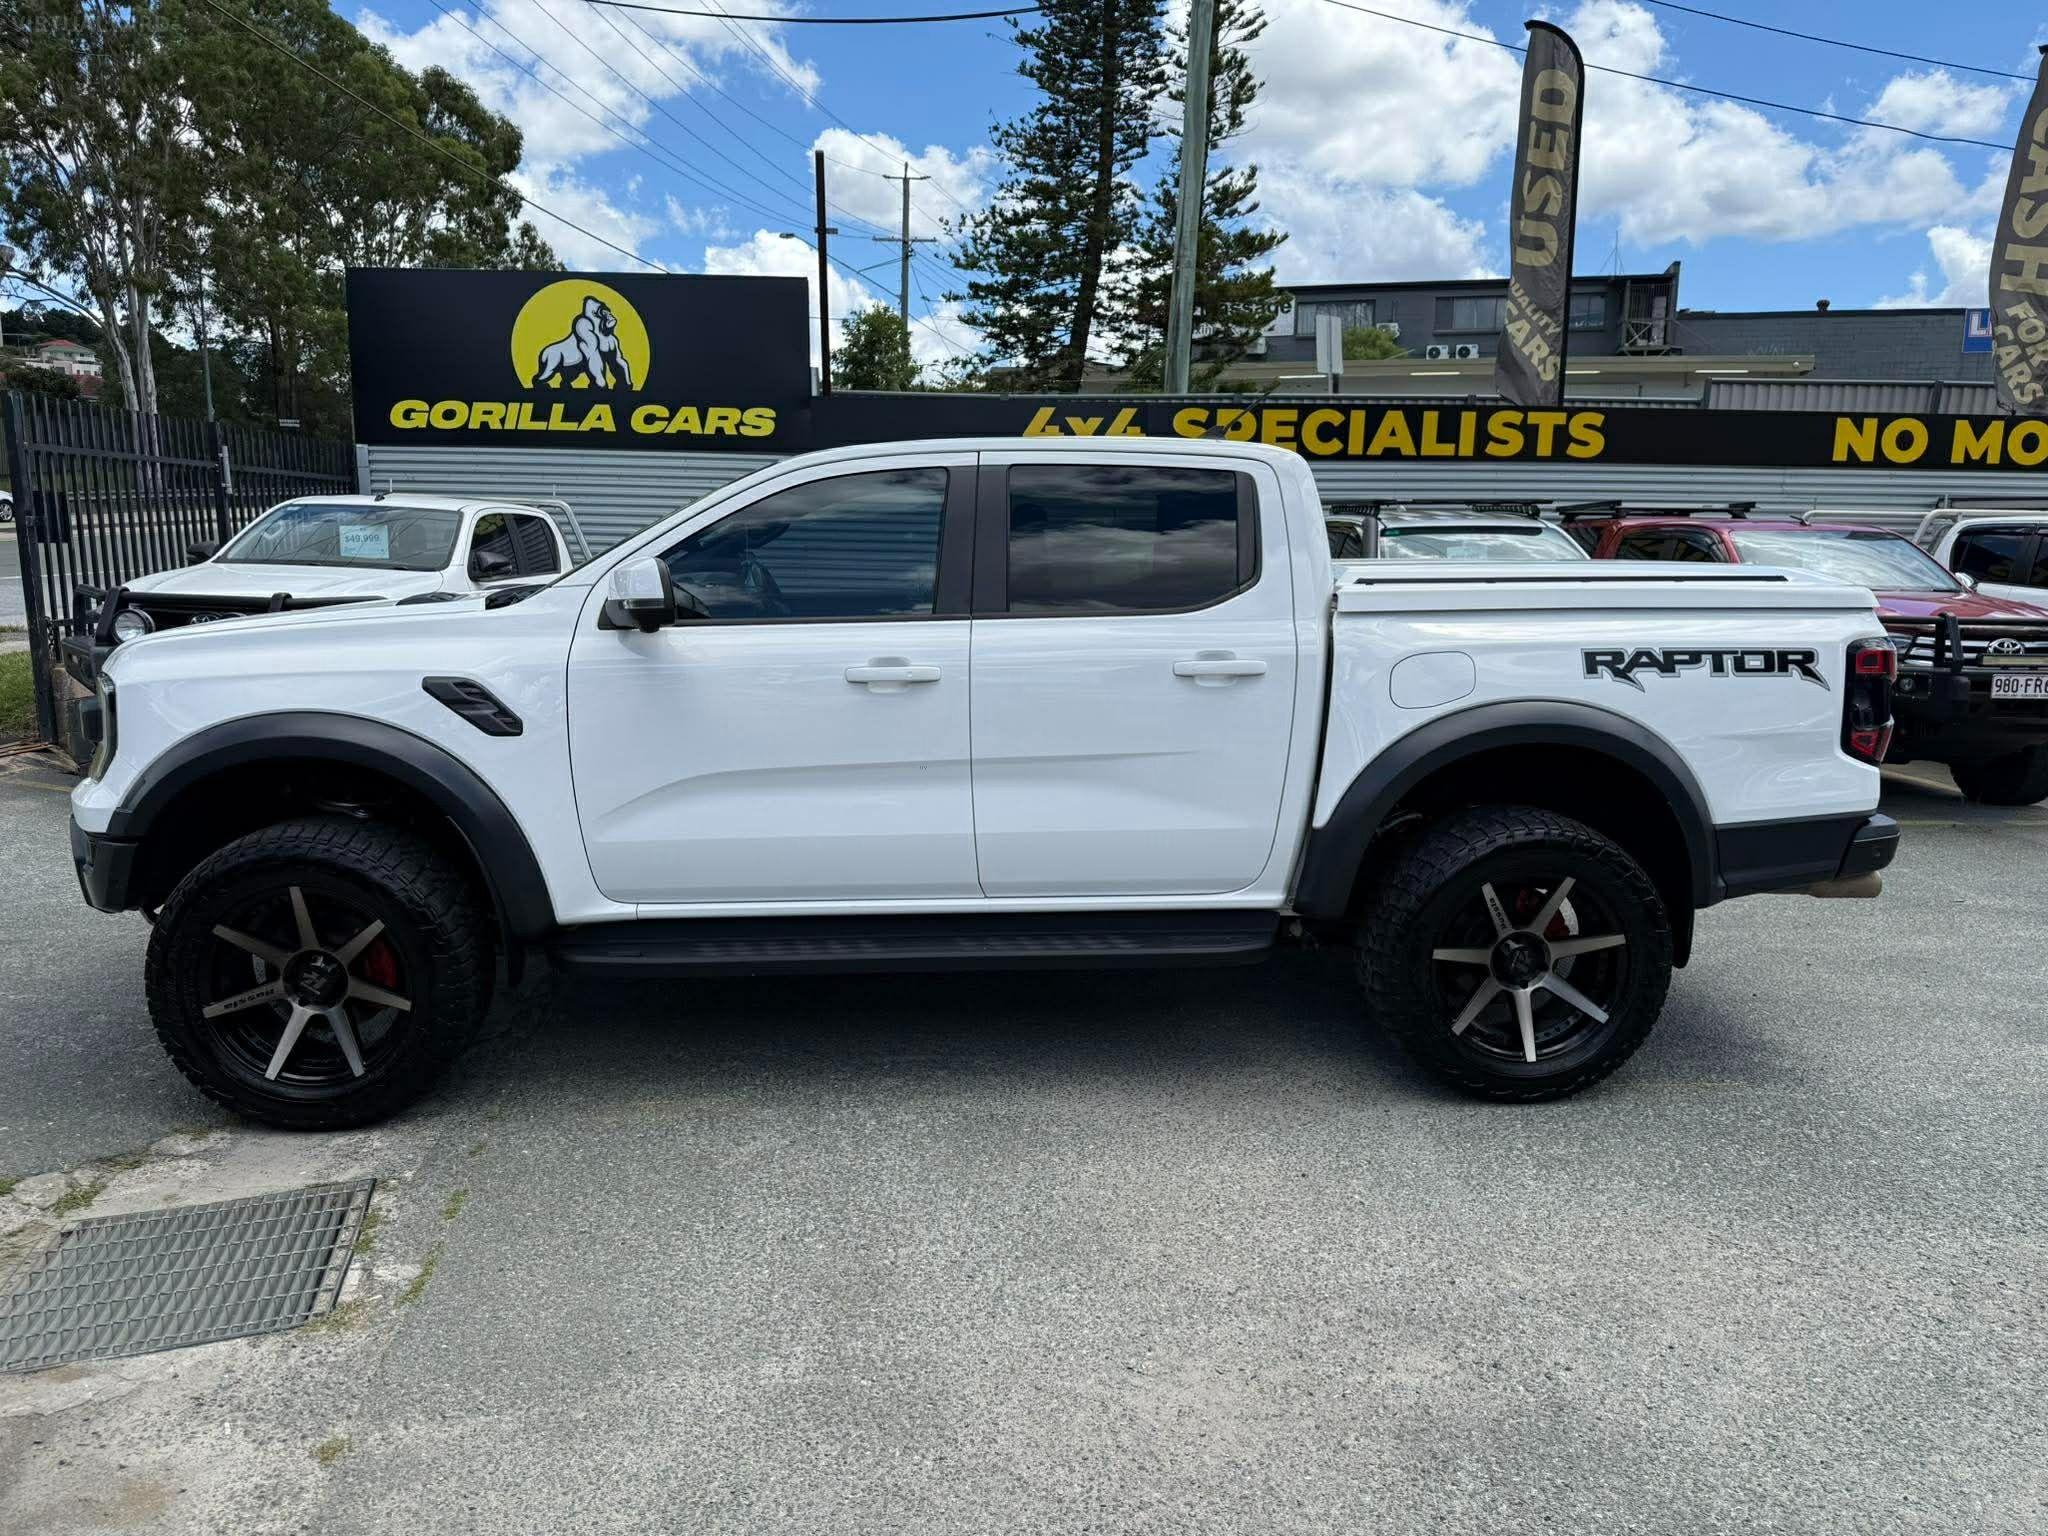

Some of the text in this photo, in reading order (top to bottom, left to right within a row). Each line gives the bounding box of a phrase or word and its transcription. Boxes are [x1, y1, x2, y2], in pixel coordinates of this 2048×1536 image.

[1514, 68, 1577, 268] USED
[389, 400, 776, 437] GORILLA CARS
[1022, 406, 1606, 459] 4x4 SPECIALISTS
[1832, 417, 2048, 467] NO MO
[1580, 647, 1831, 693] RAPTOR
